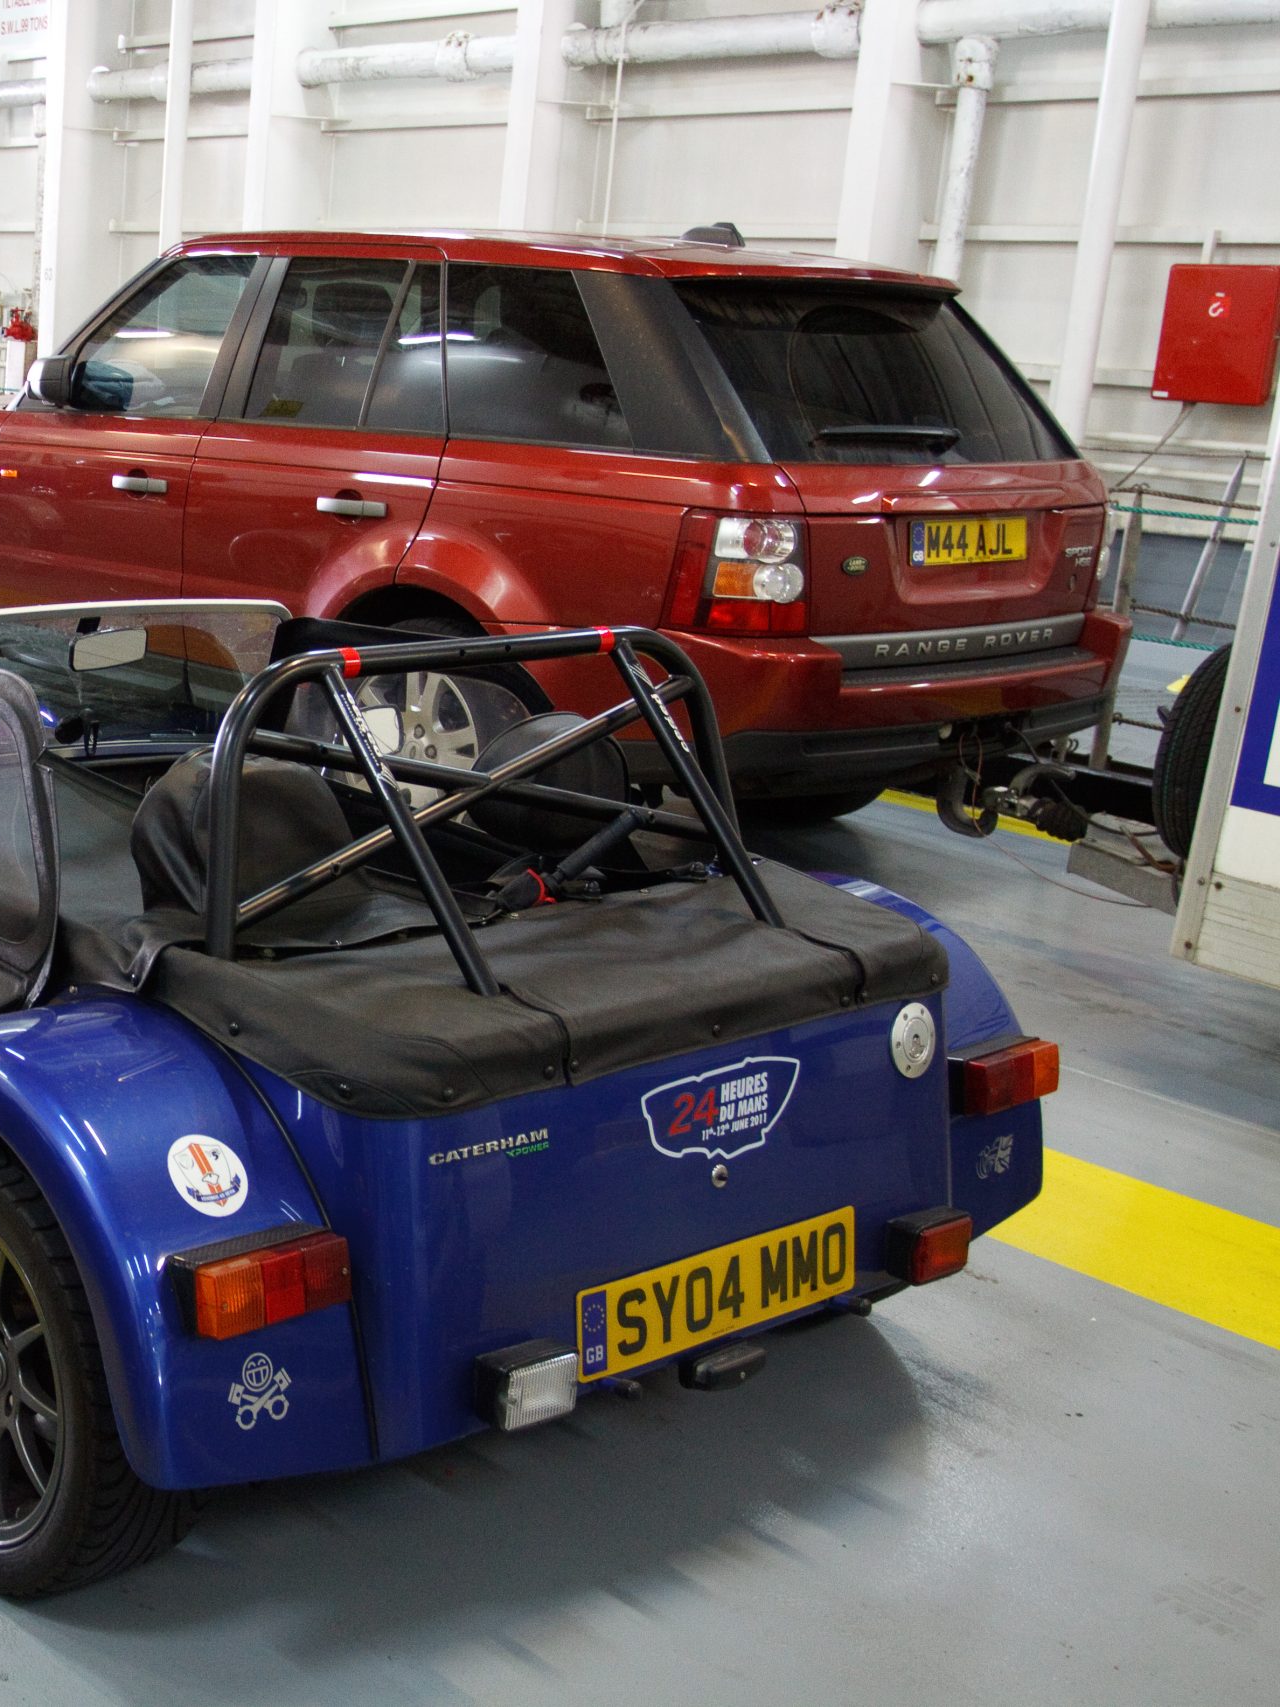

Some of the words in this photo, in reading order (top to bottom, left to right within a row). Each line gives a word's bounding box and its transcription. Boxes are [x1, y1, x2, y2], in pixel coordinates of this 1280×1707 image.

[30, 15, 48, 31] TONS
[927, 524, 969, 558] M44
[976, 523, 1013, 556] AJL
[1065, 546, 1093, 557] SPORT
[913, 551, 924, 561] GB
[875, 638, 968, 658] RANGE
[983, 628, 1053, 649] ROVER
[721, 1072, 768, 1103] HEURES
[668, 1087, 719, 1137] 24
[719, 1104, 734, 1122] DU
[737, 1094, 768, 1118] MANS
[731, 1117, 749, 1133] JUNE
[750, 1112, 767, 1128] 2011
[429, 1128, 549, 1166] CATERHAM
[617, 1254, 745, 1357] SY04
[760, 1222, 846, 1309] MMO
[586, 1345, 604, 1365] GB
